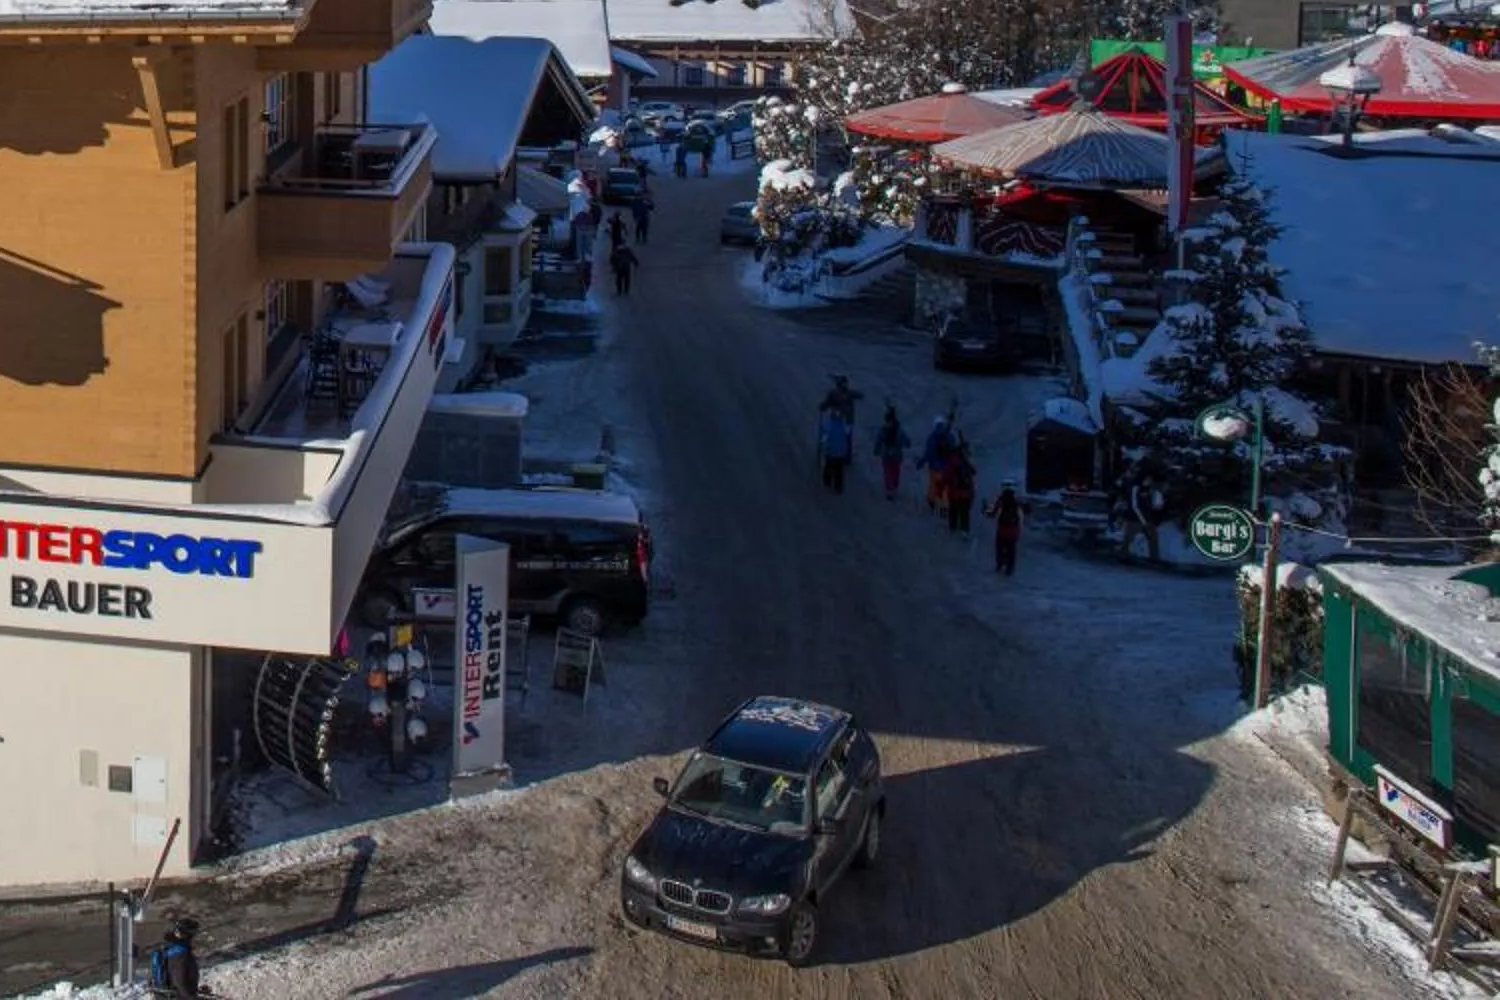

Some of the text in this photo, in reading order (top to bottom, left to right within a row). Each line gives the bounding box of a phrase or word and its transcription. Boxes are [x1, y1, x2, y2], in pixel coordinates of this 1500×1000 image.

[10, 575, 153, 620] BAUER
[463, 583, 484, 719] INTERSPORT
[484, 609, 502, 701] Rent
